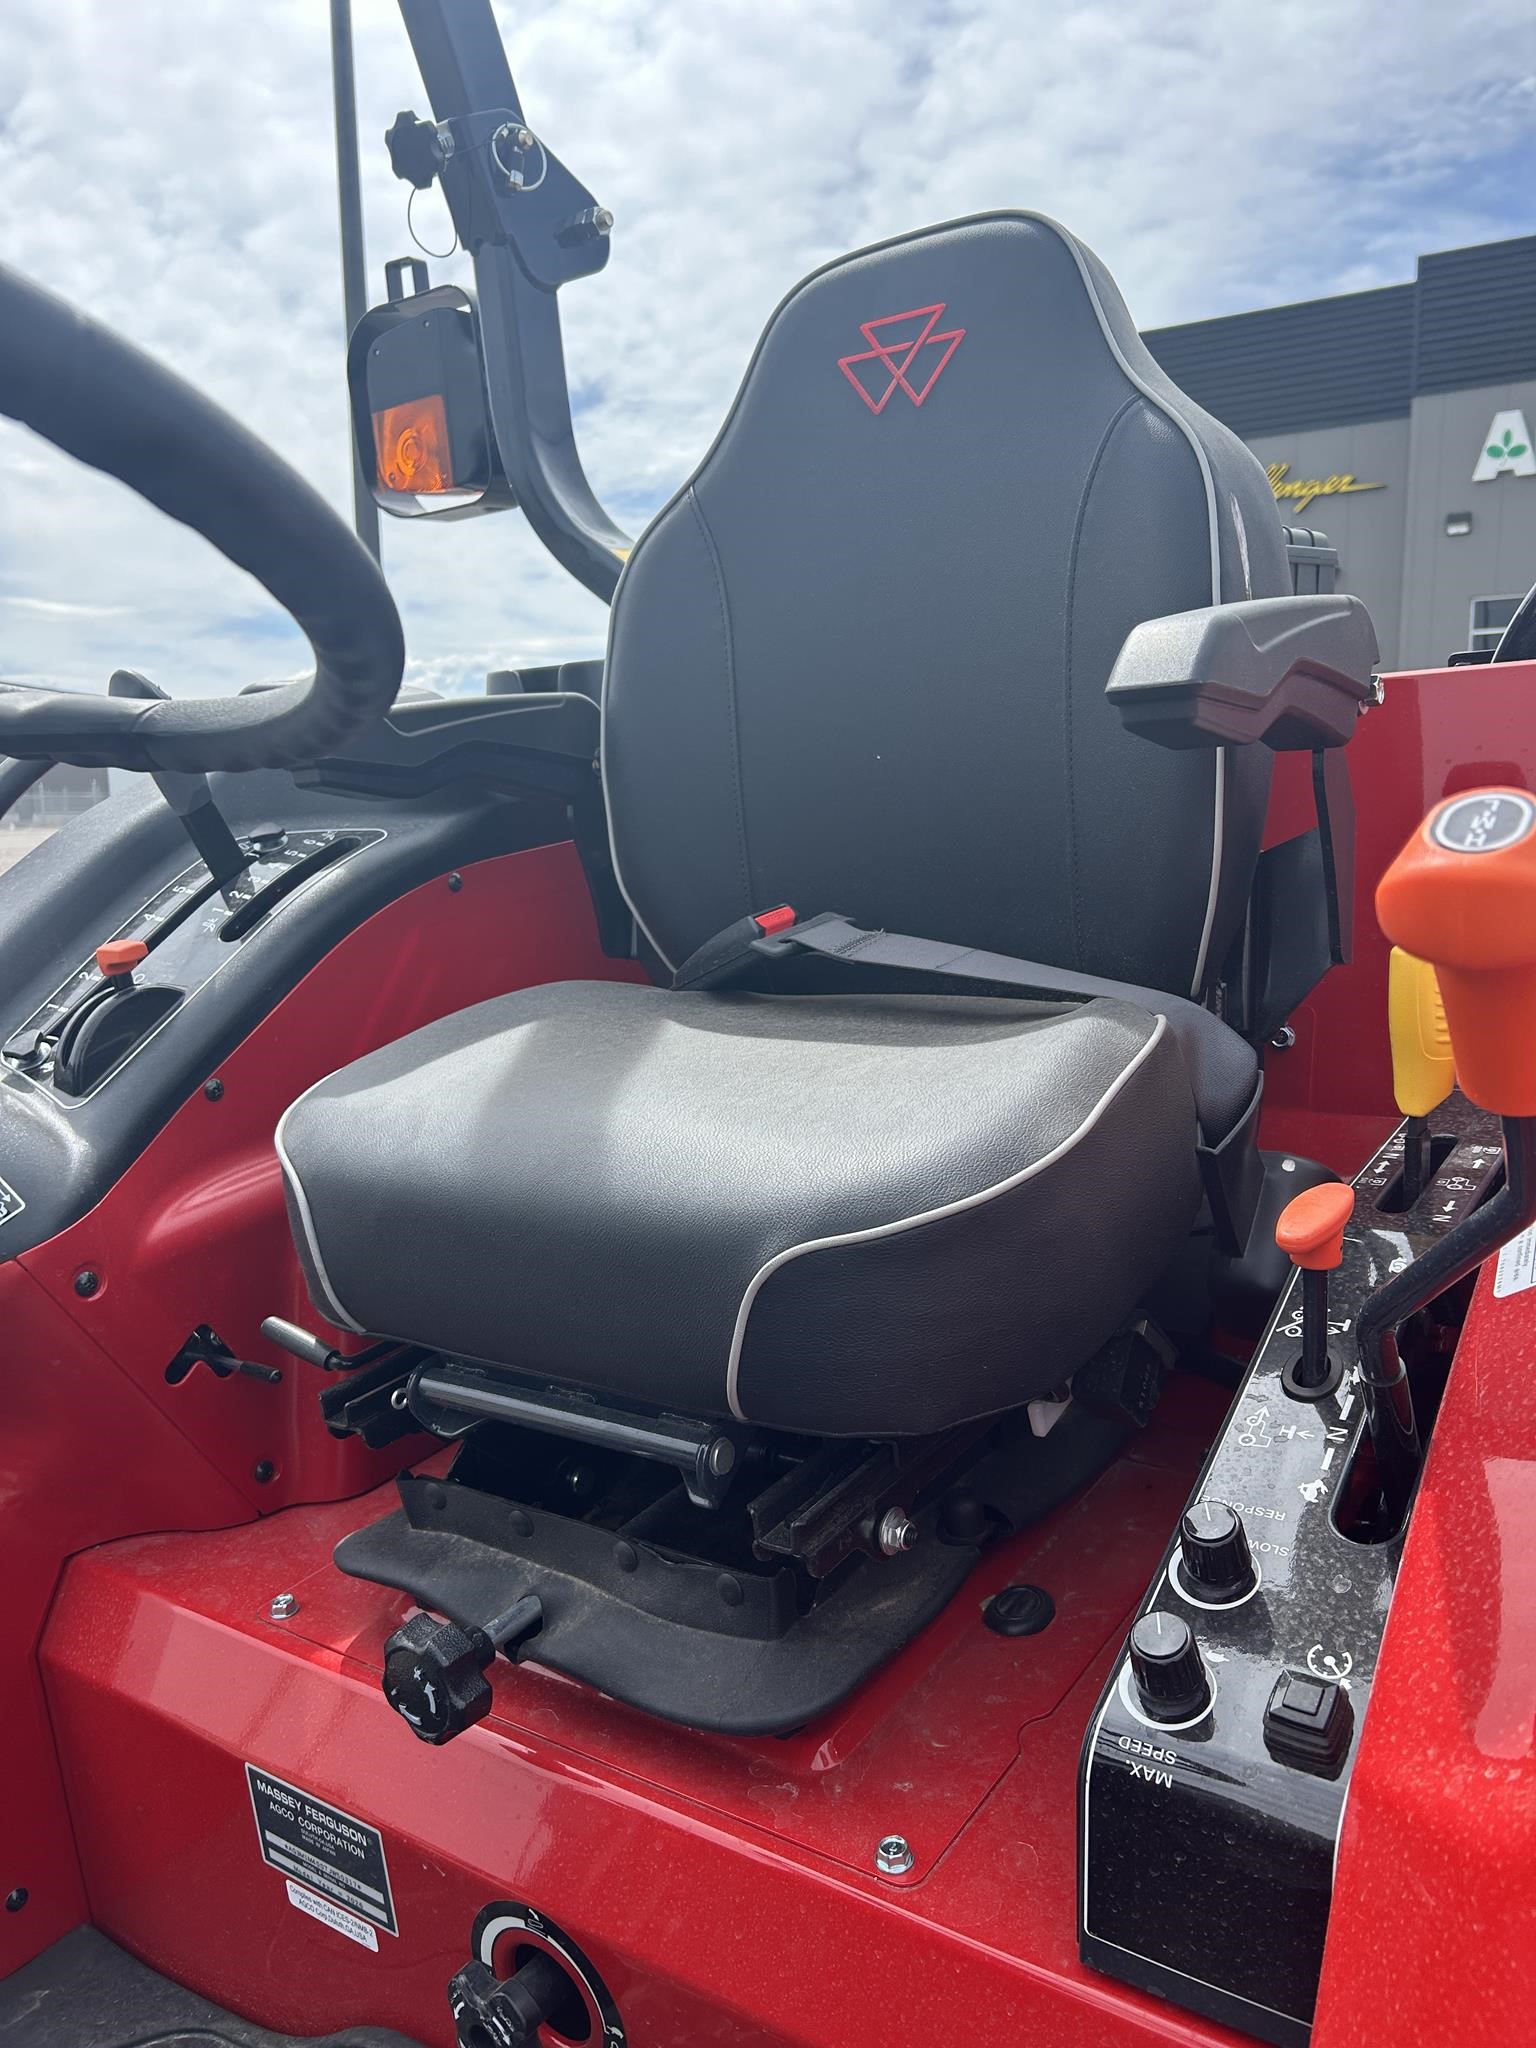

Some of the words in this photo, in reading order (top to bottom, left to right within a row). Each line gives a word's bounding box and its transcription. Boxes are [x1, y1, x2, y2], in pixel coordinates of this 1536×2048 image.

[1118, 1735, 1178, 1765] SPEED
[1125, 1760, 1173, 1789] MAX.
[256, 1780, 302, 1812] MASSEY
[305, 1804, 367, 1847] FERGUSON
[269, 1801, 295, 1821] AGCO
[297, 1816, 365, 1859] CORPORATION
